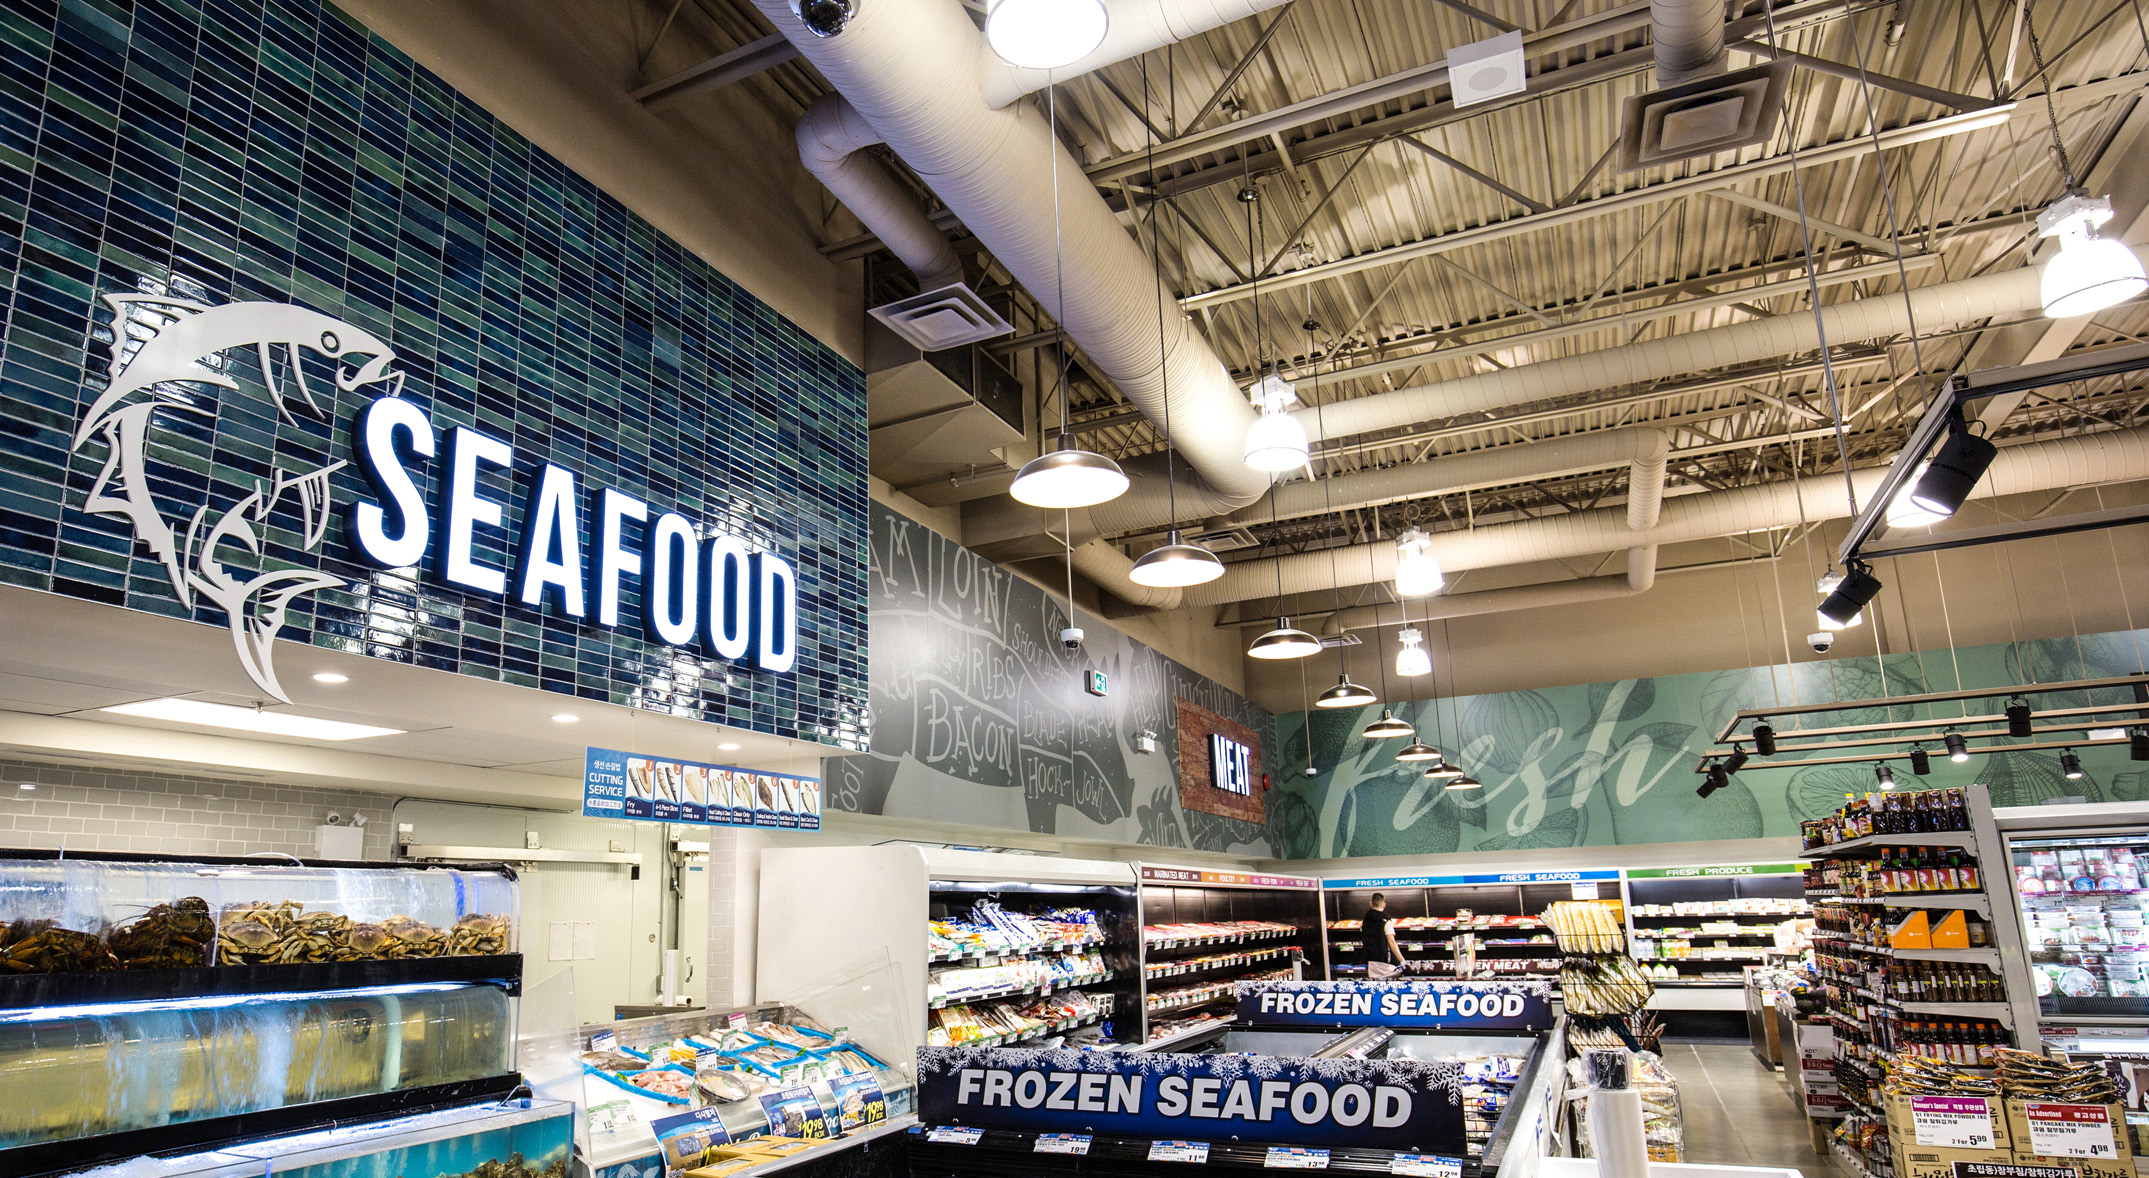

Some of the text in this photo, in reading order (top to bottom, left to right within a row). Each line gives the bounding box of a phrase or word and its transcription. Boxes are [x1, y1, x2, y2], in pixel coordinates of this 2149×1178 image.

[357, 397, 796, 673] SEAFOOD
[869, 514, 926, 599] AM
[937, 536, 1002, 634] LOIN
[971, 642, 1016, 701] RIBS
[926, 688, 1015, 777] BACON
[1023, 700, 1068, 749] BLADE
[1078, 700, 1115, 744] HEAD
[589, 773, 624, 785] CUTTING
[594, 760, 621, 771] 생선 손질법
[726, 771, 731, 779] 4
[750, 774, 754, 783] 5
[1027, 757, 1065, 799] HOCK
[1212, 733, 1250, 796] MEAT
[588, 785, 622, 797] SERVICE
[815, 782, 819, 790] 8
[1076, 770, 1107, 825] JOWL
[1154, 871, 1177, 880] MARINATED
[1178, 872, 1189, 880] MEAT
[1704, 866, 1753, 875] PRODUCE
[1443, 962, 1528, 970] FREN MEAT
[1260, 992, 1524, 1018] FROZEN SEAFOOD
[956, 1069, 1414, 1129] FROZEN SEAFOOD
[815, 1130, 825, 1139] BOX
